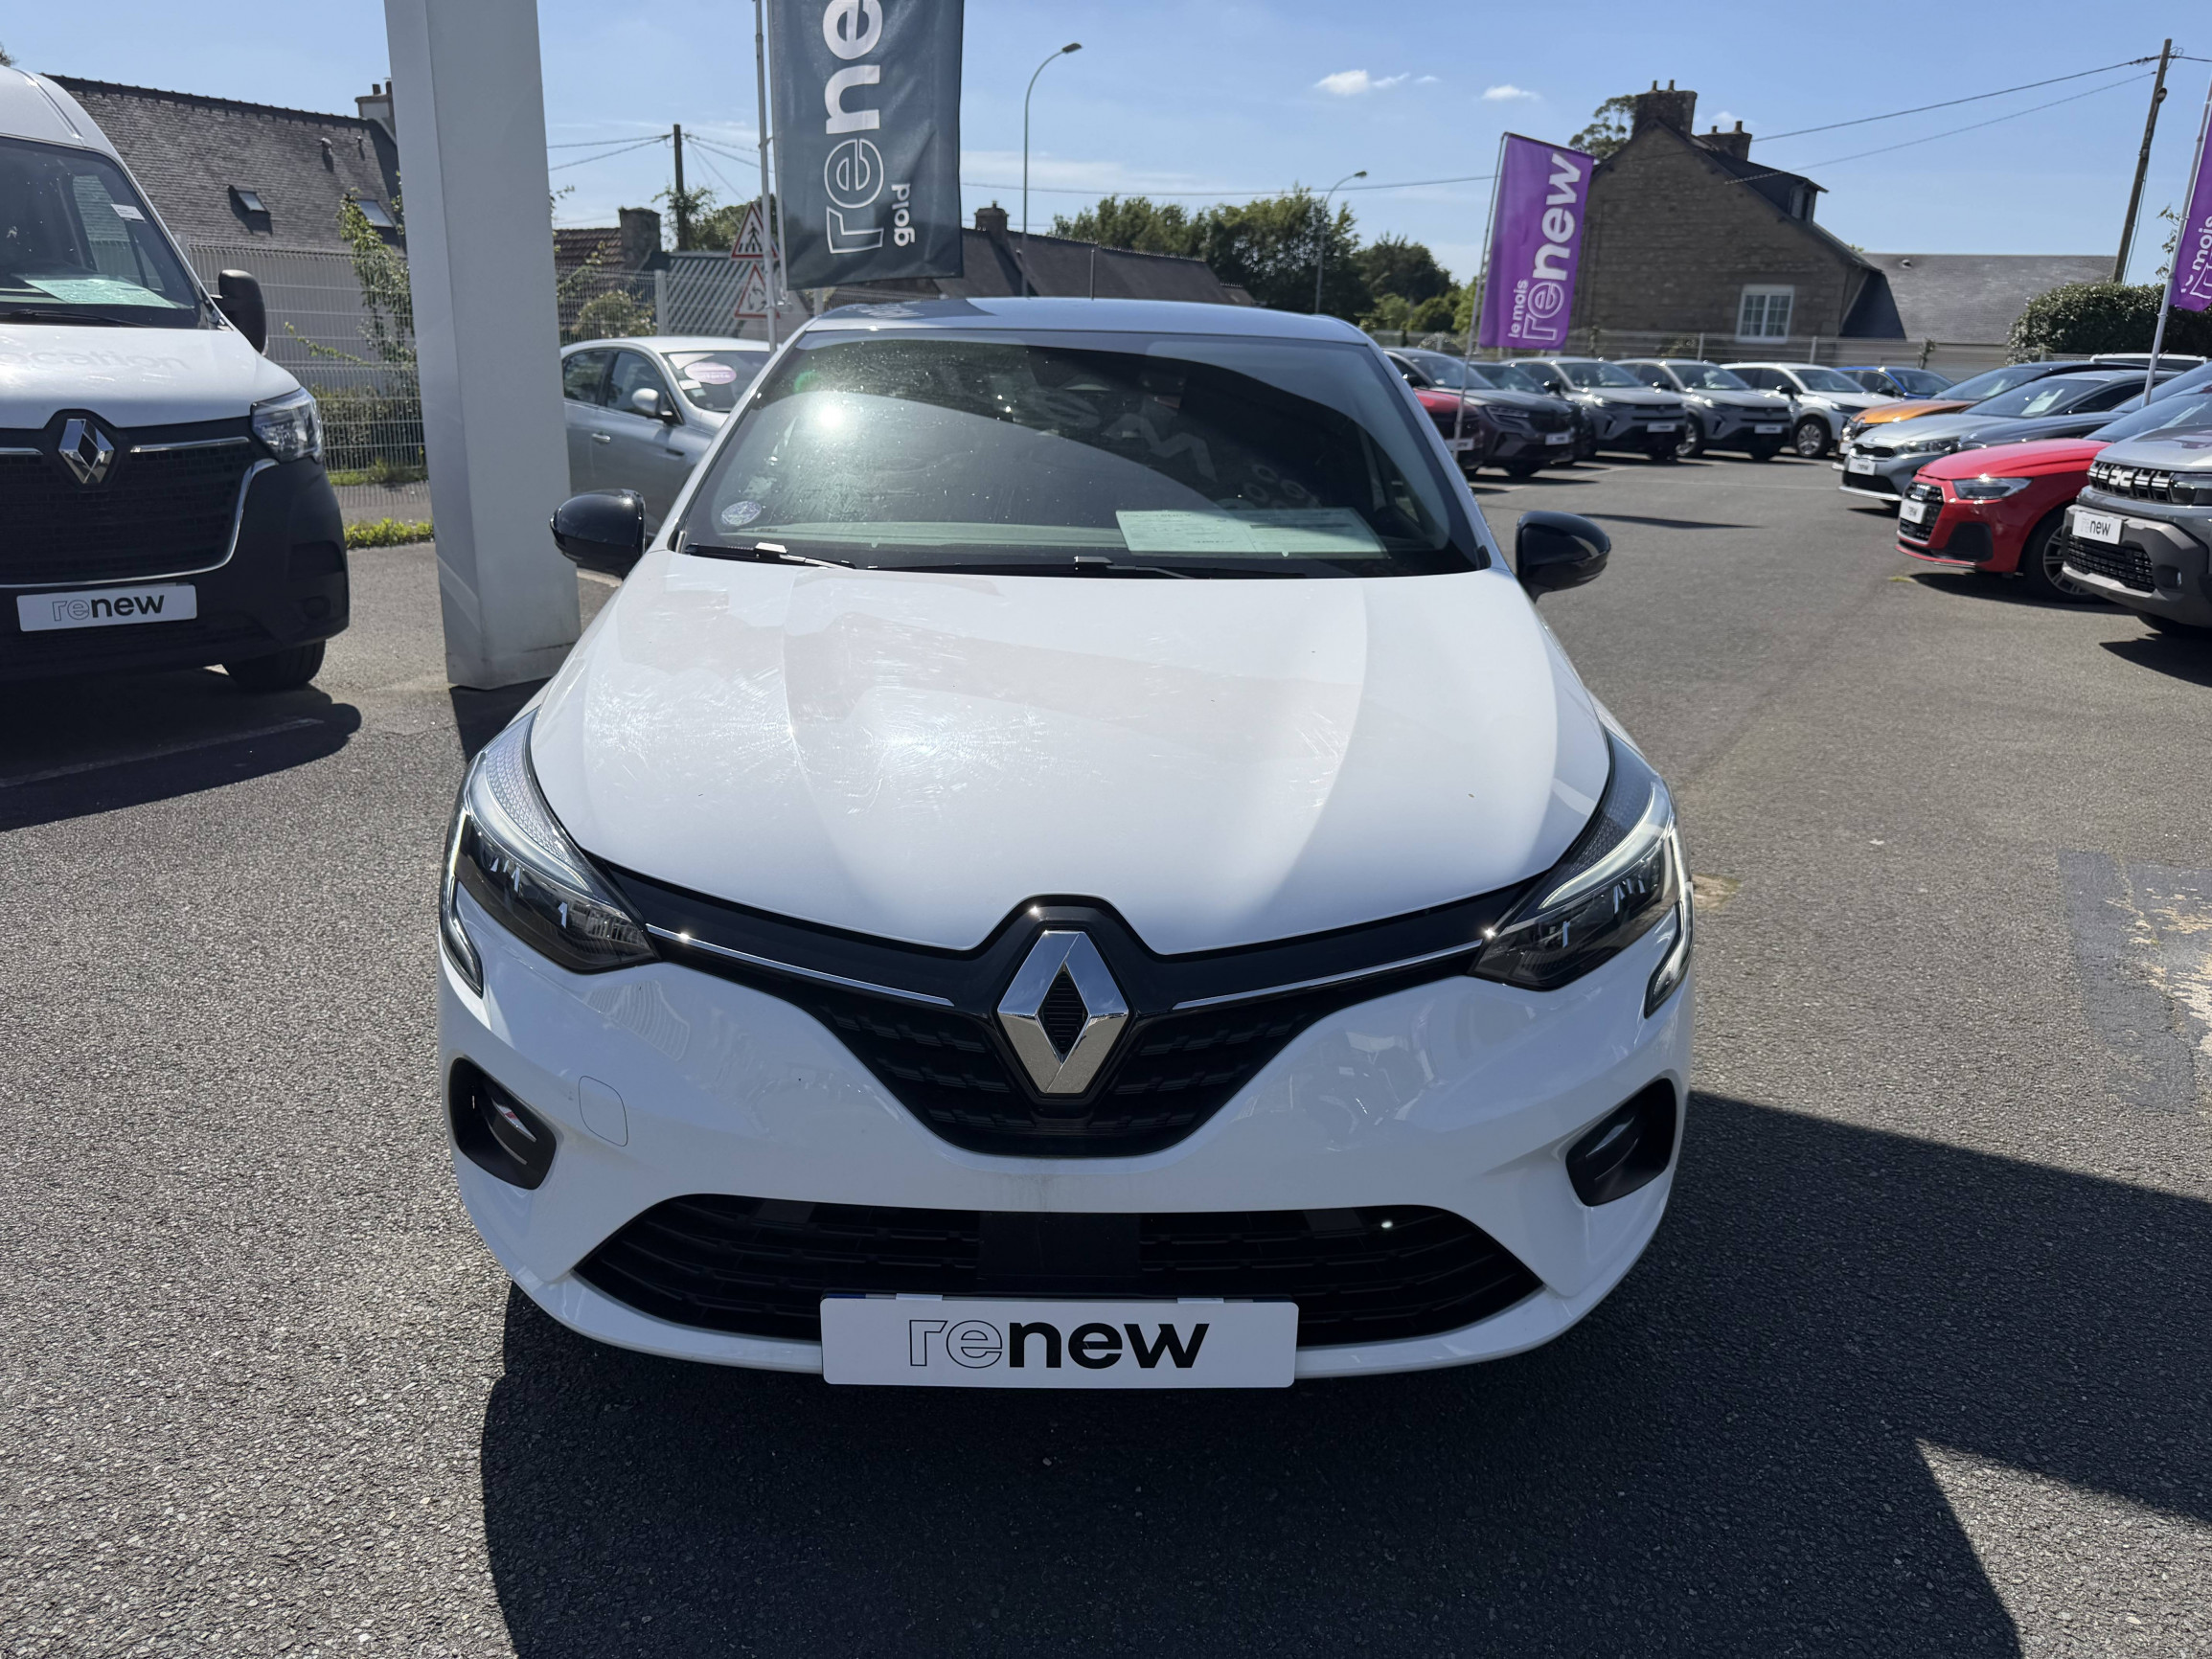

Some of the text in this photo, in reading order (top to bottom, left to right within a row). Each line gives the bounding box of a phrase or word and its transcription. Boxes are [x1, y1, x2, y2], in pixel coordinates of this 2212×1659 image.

[891, 183, 916, 247] gold
[1522, 153, 1581, 340] renew
[1508, 279, 1529, 338] le mois
[2080, 517, 2111, 537] new
[52, 595, 165, 622] renew
[909, 1320, 1210, 1369] renew
